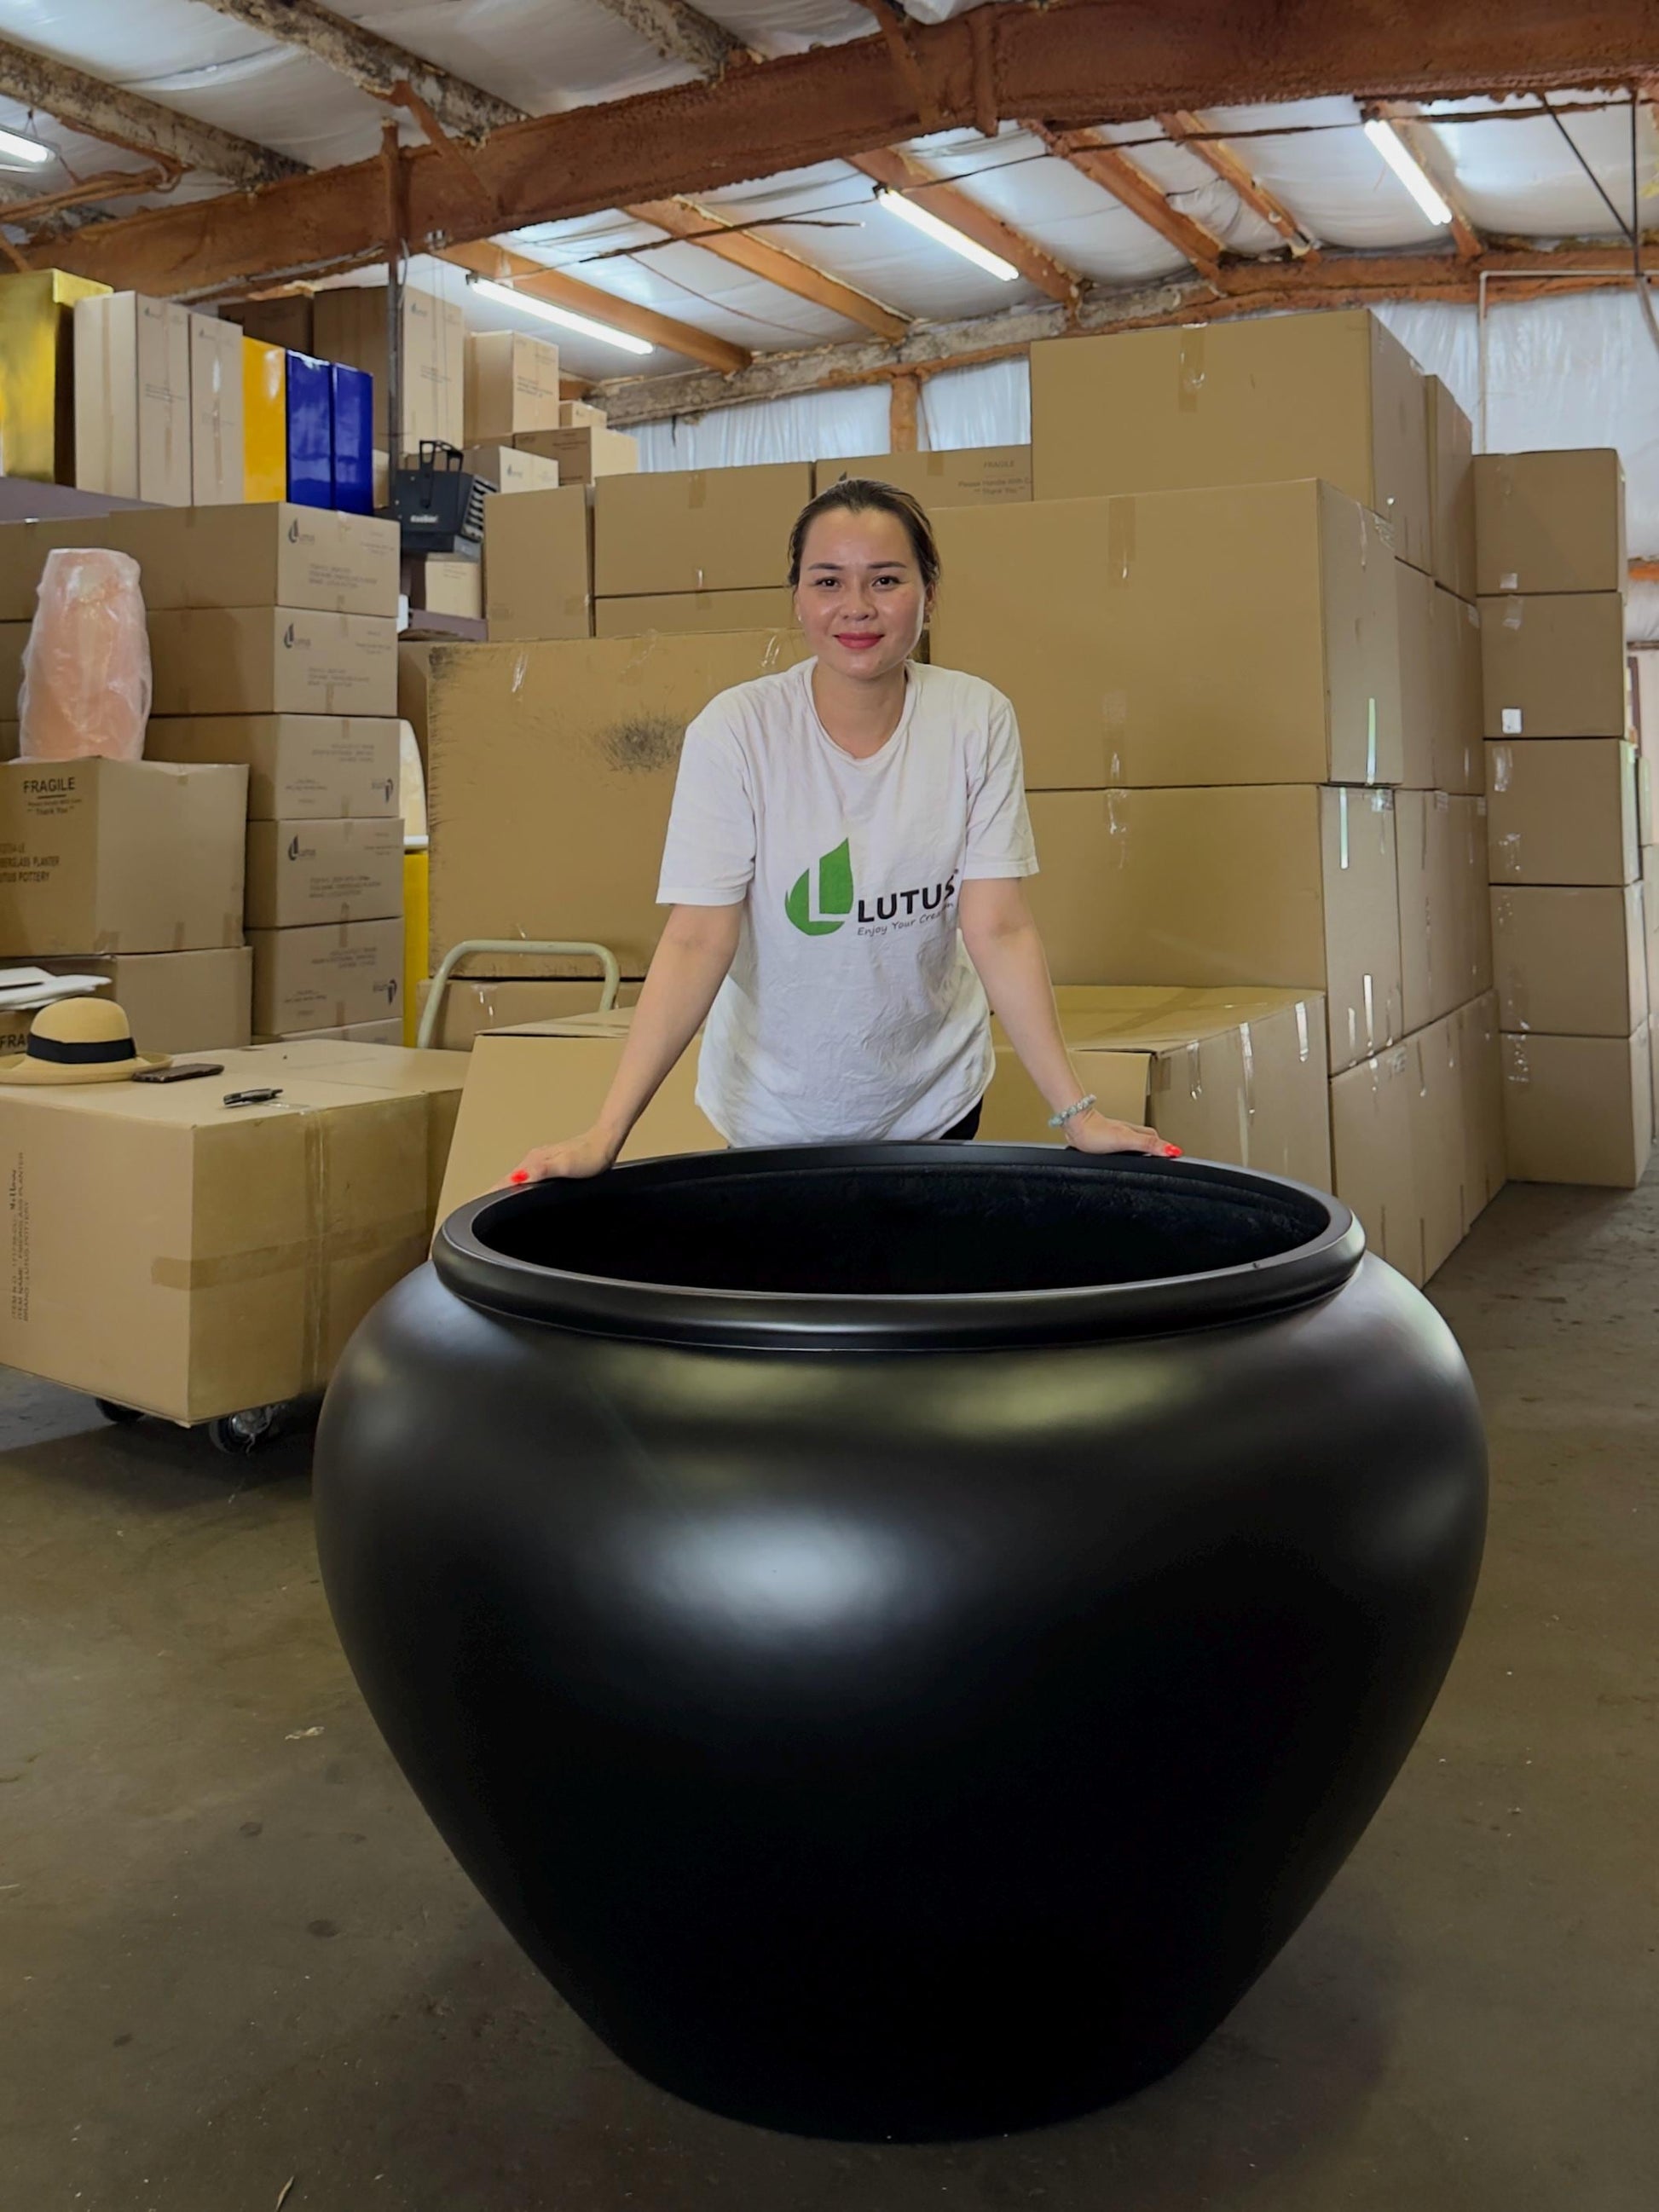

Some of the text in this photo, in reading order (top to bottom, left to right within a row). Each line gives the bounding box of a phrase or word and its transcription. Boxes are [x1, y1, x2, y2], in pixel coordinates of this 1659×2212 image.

[23, 777, 75, 793] FRAGILE
[858, 875, 954, 922] LUTUS
[858, 925, 887, 937] Enjoy
[892, 920, 915, 930] Your
